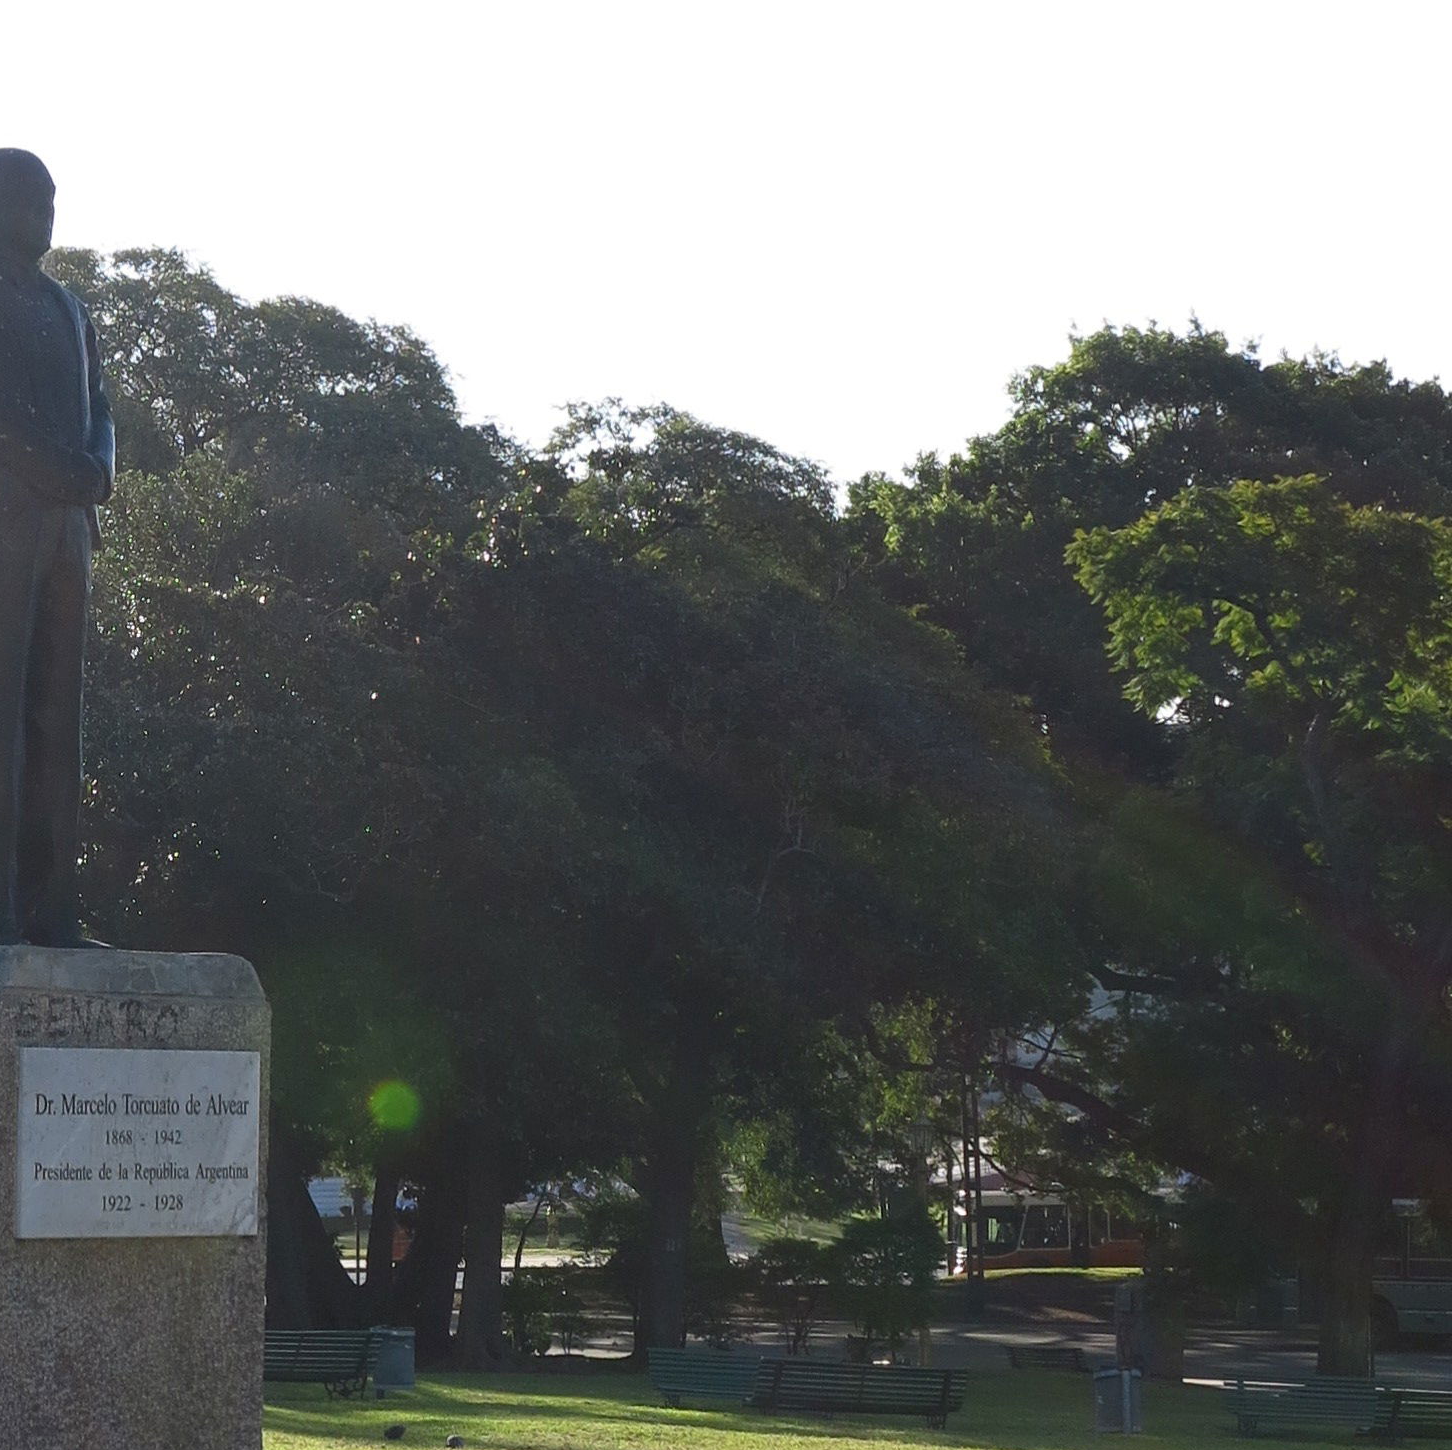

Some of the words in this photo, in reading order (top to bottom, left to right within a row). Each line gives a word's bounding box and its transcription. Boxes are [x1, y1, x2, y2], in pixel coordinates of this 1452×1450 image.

[35, 1093, 56, 1116] Dr.
[61, 1093, 117, 1116] Marcelo
[121, 1093, 180, 1116] Torcuato
[185, 1093, 201, 1116] de
[205, 1093, 249, 1116] Alvear
[105, 1130, 133, 1145] 1868
[154, 1130, 182, 1145] 1942
[34, 1162, 93, 1181] Presidente
[98, 1163, 113, 1181] de
[118, 1163, 128, 1181] la
[134, 1163, 189, 1185] República
[195, 1163, 249, 1184] Argentina
[101, 1195, 131, 1211] 1922
[154, 1195, 184, 1211] 1928
